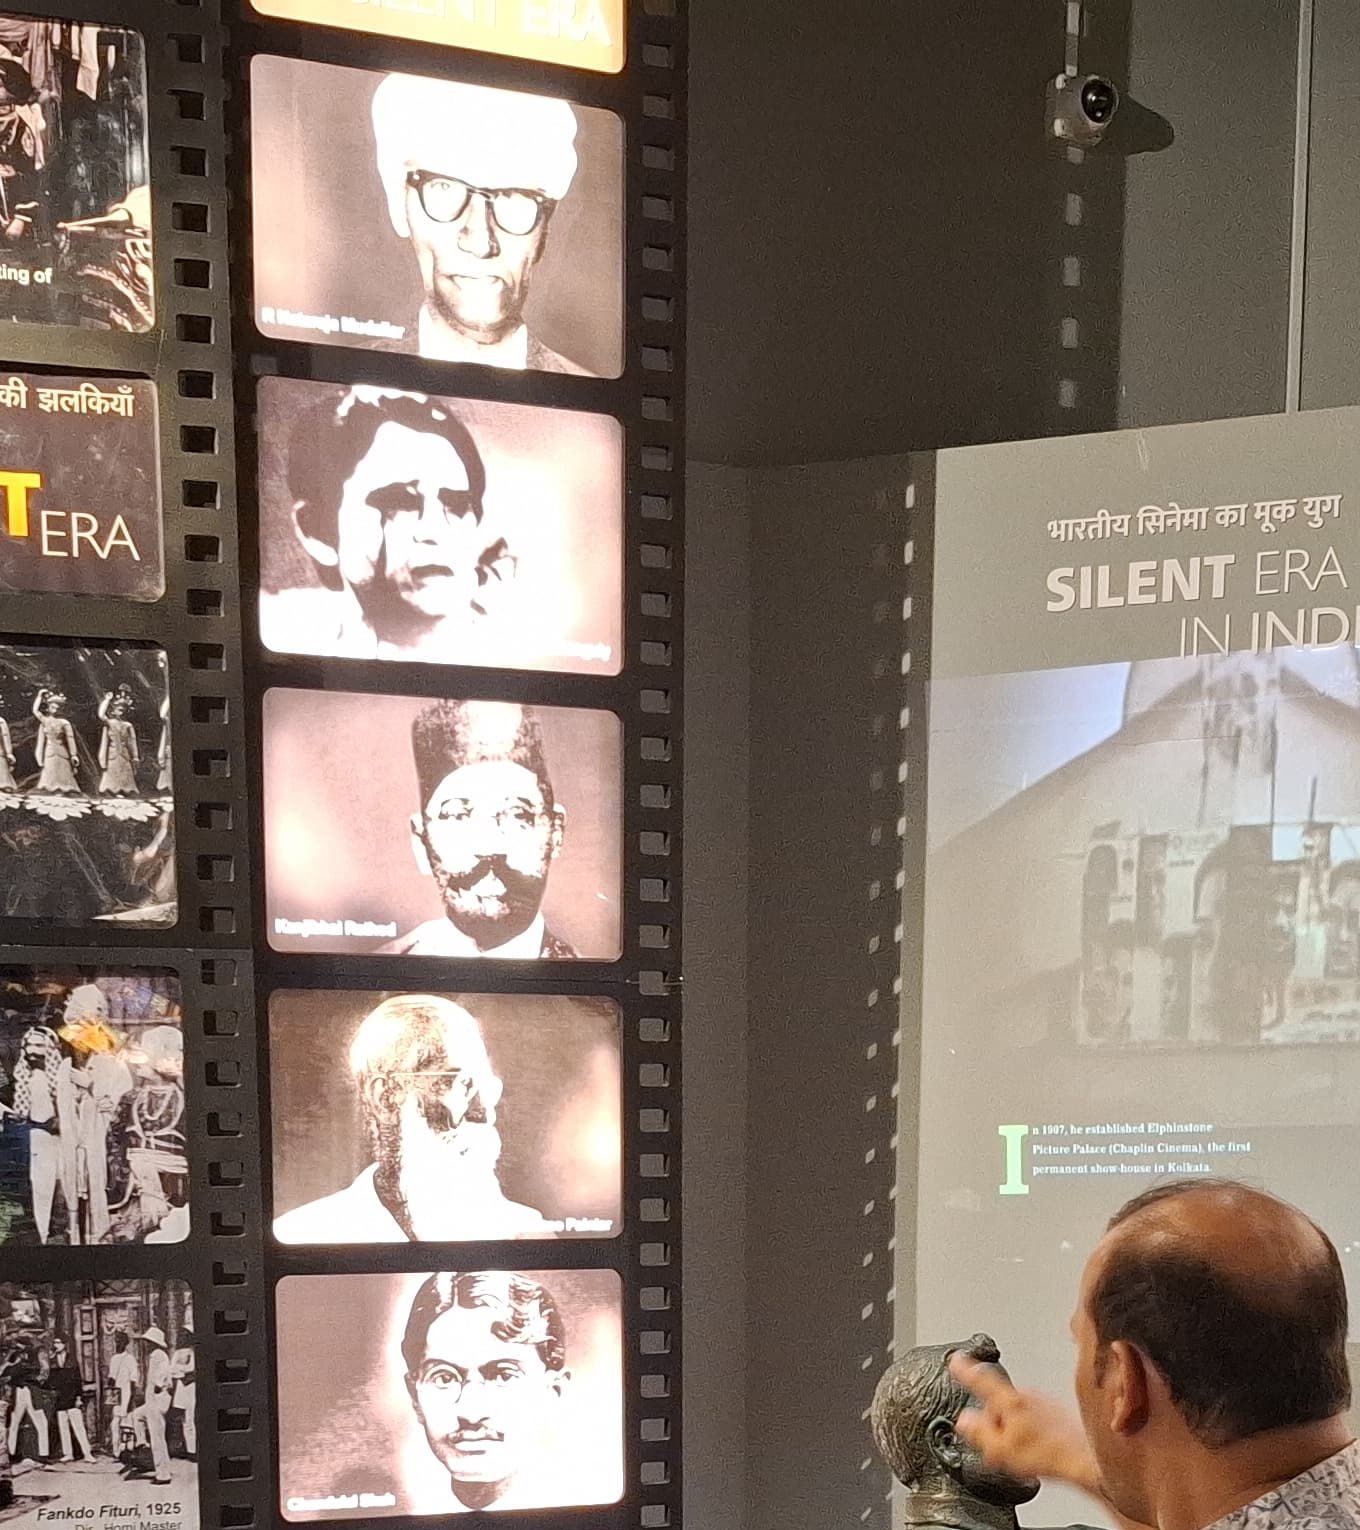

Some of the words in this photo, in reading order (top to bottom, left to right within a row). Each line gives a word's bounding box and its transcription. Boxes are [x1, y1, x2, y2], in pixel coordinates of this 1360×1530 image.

[34, 268, 53, 283] of
[37, 384, 135, 417] झलकियाँ
[1047, 509, 1132, 542] भारतीय
[1137, 502, 1209, 535] सिनेमा
[1215, 503, 1249, 528] का
[1253, 498, 1298, 534] मूक
[1303, 494, 1343, 529] युग
[42, 510, 141, 561] ERA
[1046, 554, 1236, 612] SILENT
[1255, 546, 1349, 596] ERA
[1180, 613, 1231, 658] IN
[1085, 1123, 1145, 1135] established
[1147, 1121, 1214, 1136] Elphinstone
[1032, 1144, 1070, 1155] Picture
[1073, 1143, 1107, 1154] Palace
[1207, 1141, 1226, 1153] the
[1228, 1141, 1251, 1153] first
[1032, 1164, 1088, 1177] permanent
[1154, 1162, 1165, 1173] in
[37, 1506, 95, 1521] Fankdo
[99, 1503, 142, 1518] Fituri,
[146, 1502, 182, 1516] 1925
